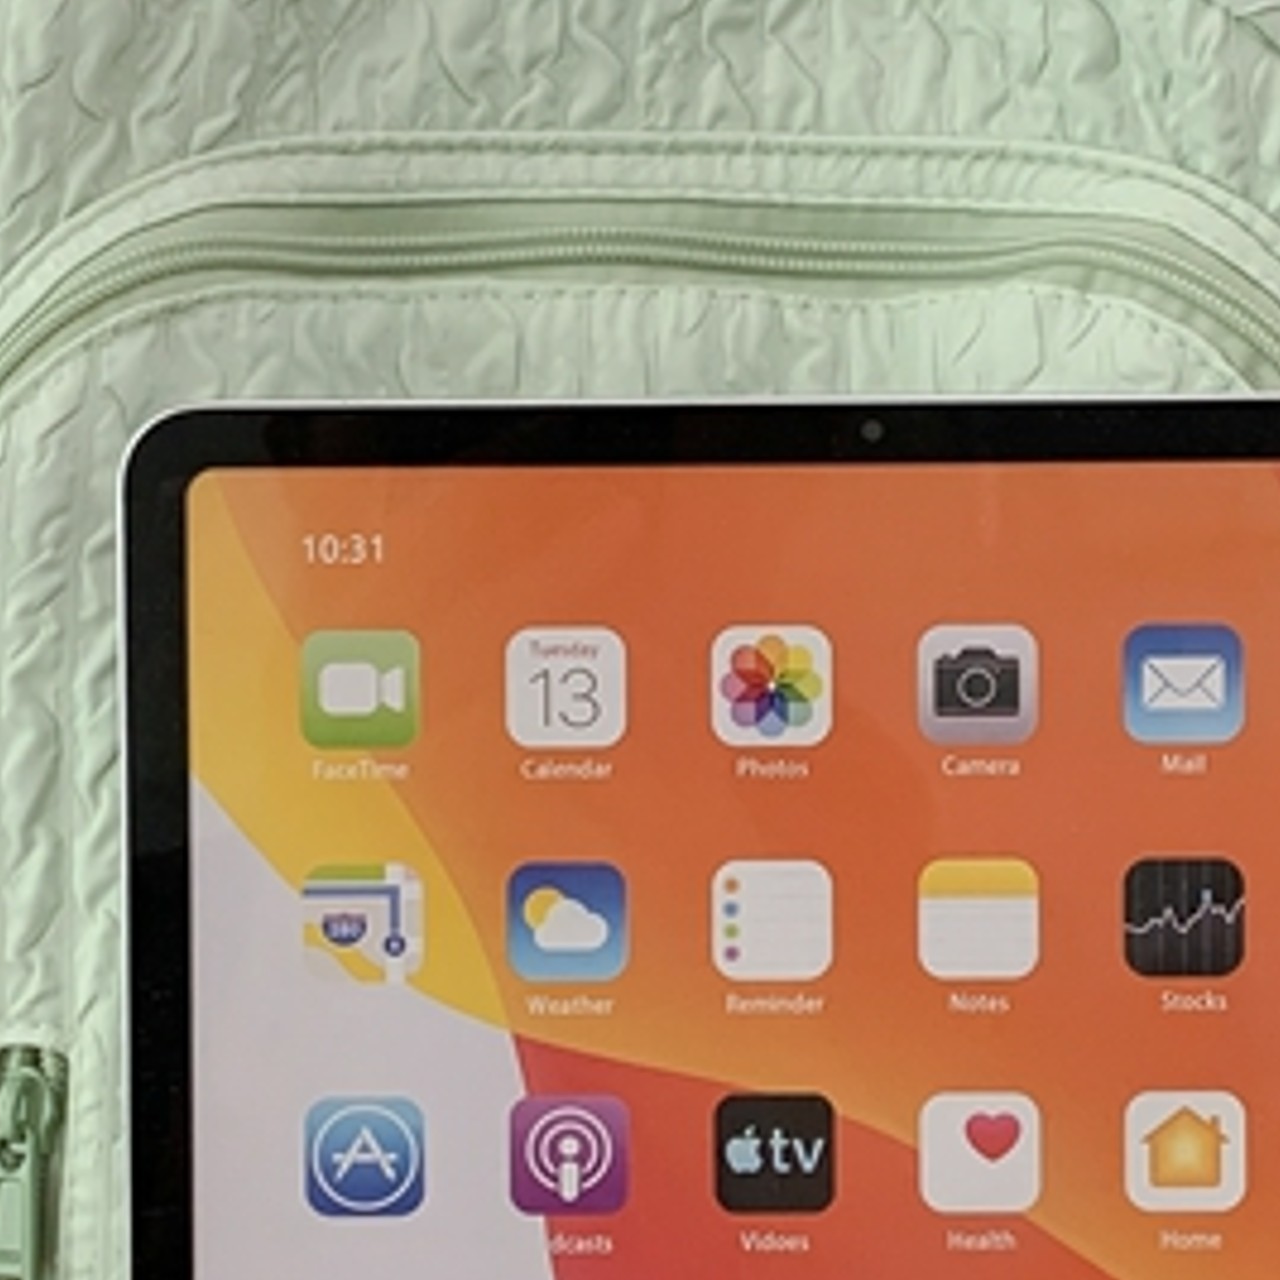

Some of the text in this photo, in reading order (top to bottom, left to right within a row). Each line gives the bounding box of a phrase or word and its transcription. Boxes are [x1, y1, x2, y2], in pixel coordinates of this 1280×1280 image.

[301, 533, 385, 565] 10:31
[530, 639, 600, 661] Tuesday
[527, 666, 603, 729] 13
[312, 758, 410, 781] FaceTime
[520, 758, 614, 780] Calendar
[735, 756, 810, 779] Photos
[941, 754, 1021, 777] Camera
[1160, 753, 1208, 775] Mail
[525, 994, 615, 1016] Weather
[725, 992, 824, 1016] Reminder
[948, 991, 1011, 1014] Notes
[1160, 989, 1228, 1012] Stocks
[768, 1127, 825, 1175] tv
[946, 1229, 1017, 1252] Health
[1159, 1229, 1223, 1252] Home
